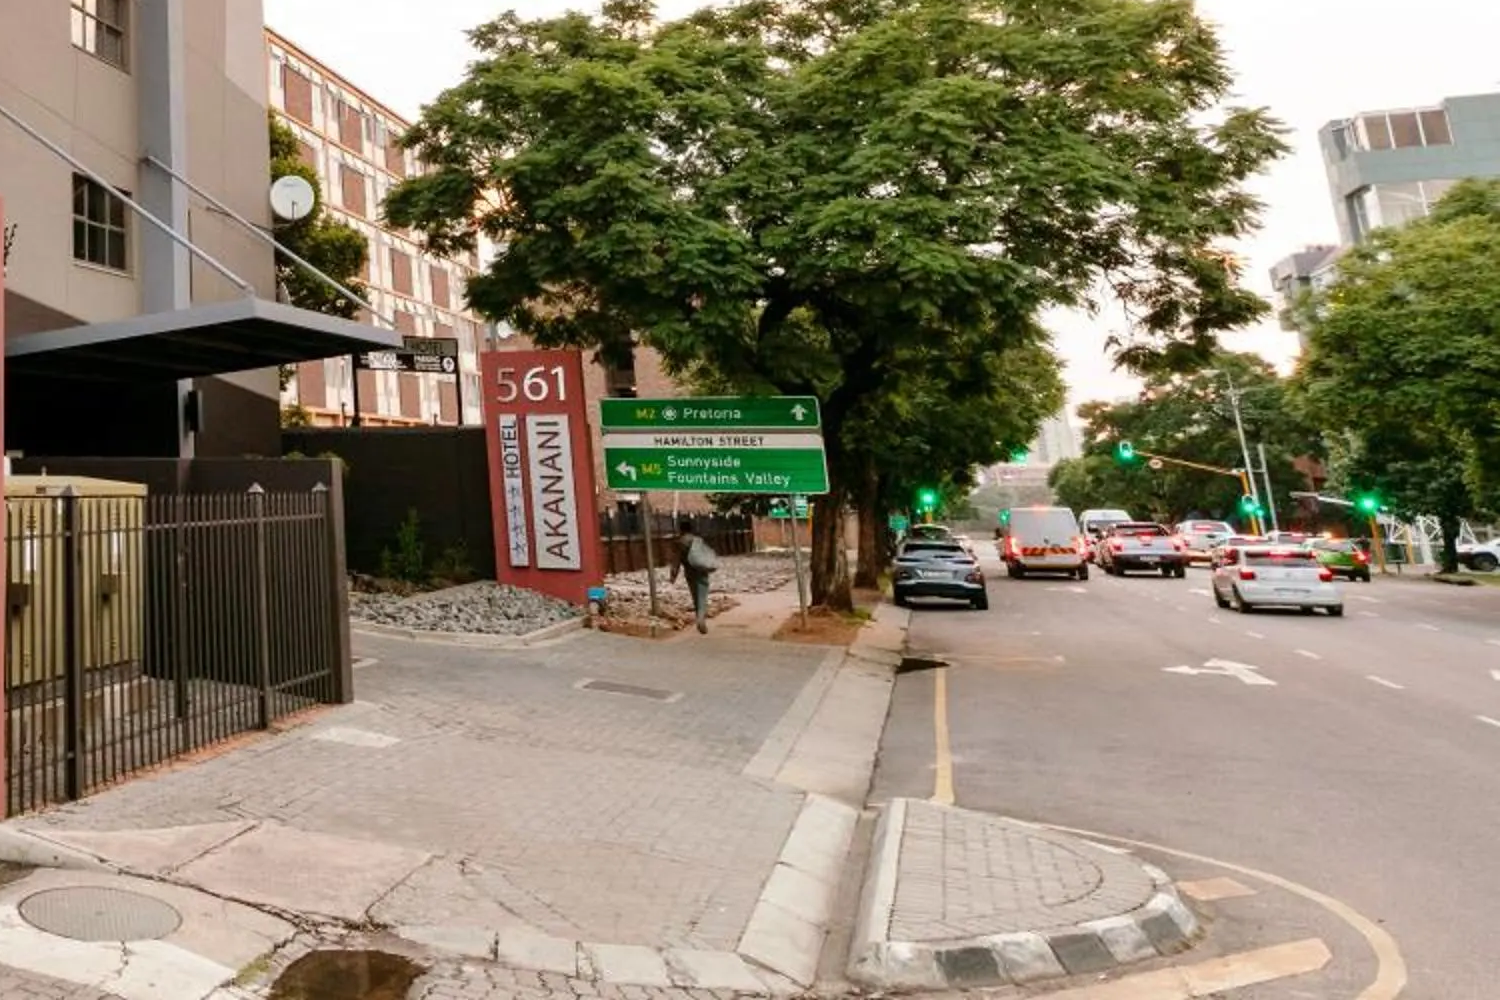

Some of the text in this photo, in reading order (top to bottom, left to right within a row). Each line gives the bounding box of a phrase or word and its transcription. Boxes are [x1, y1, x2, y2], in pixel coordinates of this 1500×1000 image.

[497, 366, 566, 402] 561
[682, 406, 742, 420] Pretoria
[501, 421, 521, 478] HOTEL
[653, 435, 764, 447] HAMILTON STREET
[667, 455, 742, 471] Sunnyside
[667, 470, 792, 489] Fountains Valley
[535, 421, 570, 561] AKANANI
